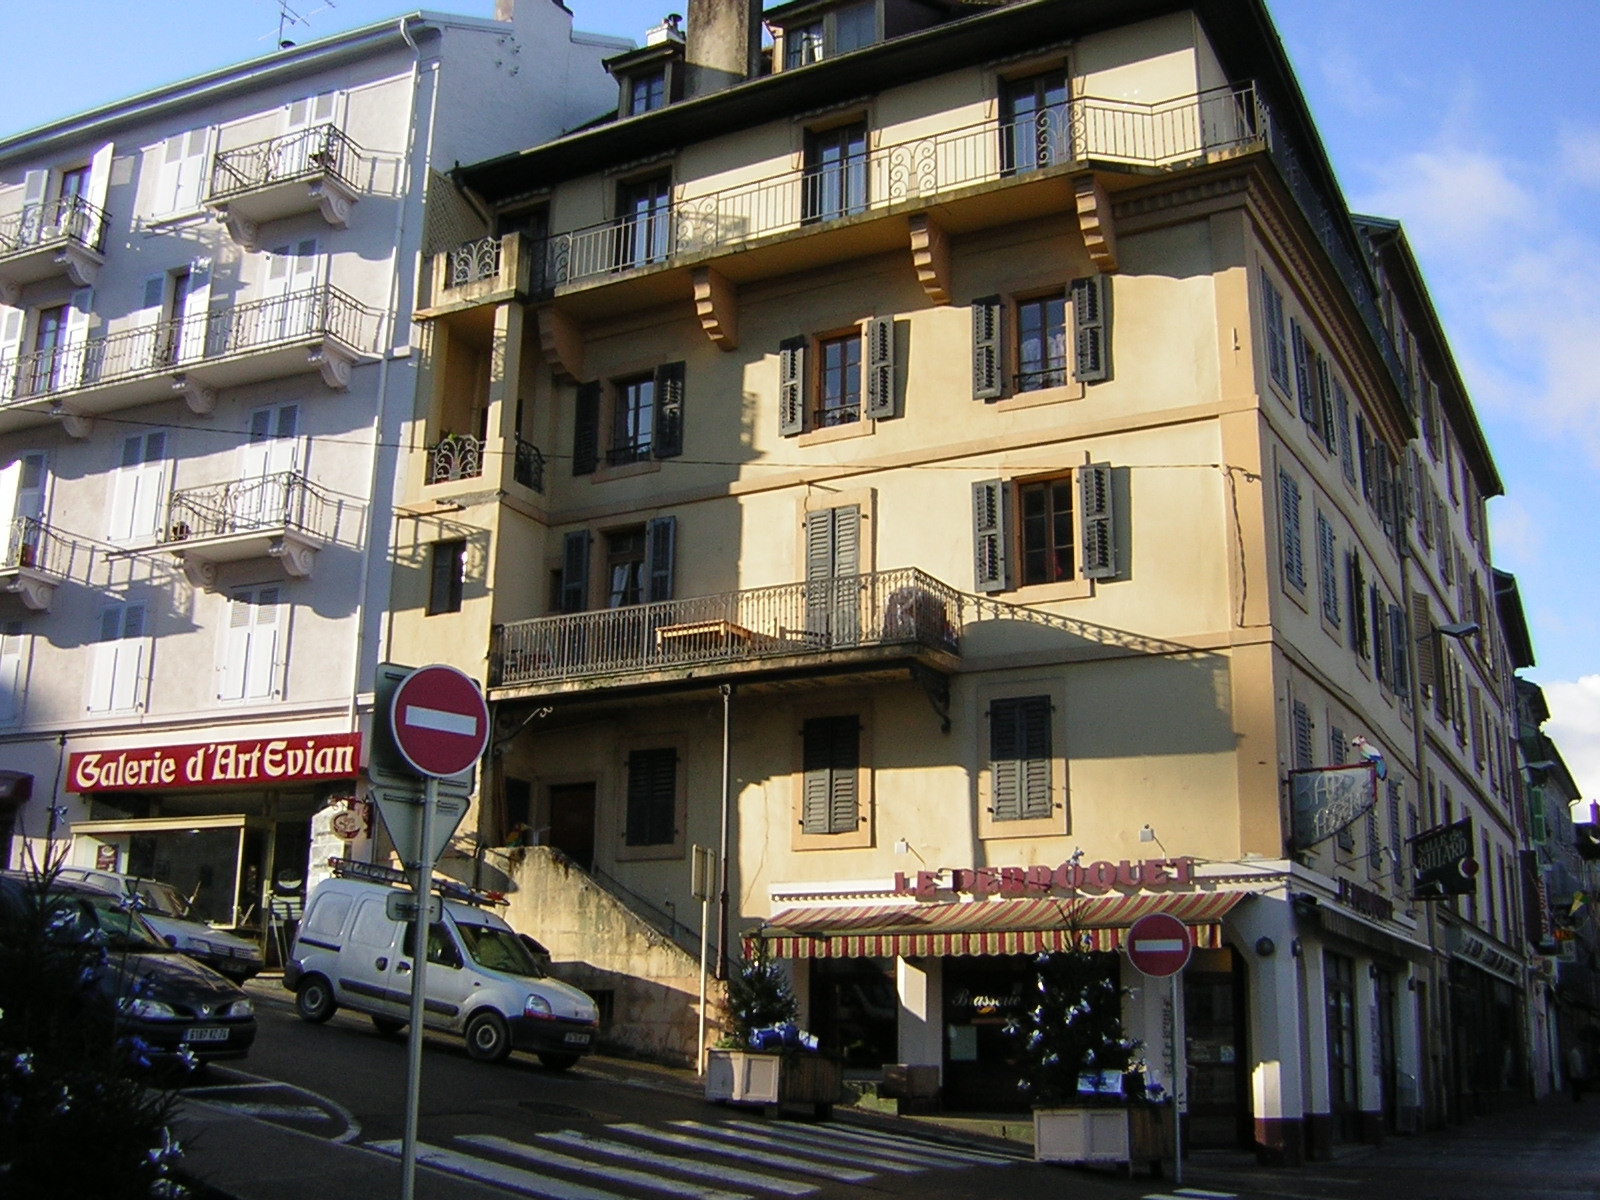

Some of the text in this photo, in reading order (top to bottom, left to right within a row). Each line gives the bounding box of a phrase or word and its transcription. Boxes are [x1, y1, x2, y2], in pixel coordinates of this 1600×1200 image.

[76, 740, 354, 788] Galerie d'Art Evian
[1418, 837, 1466, 871] BILLARD
[894, 857, 1194, 896] LE PERROQUET
